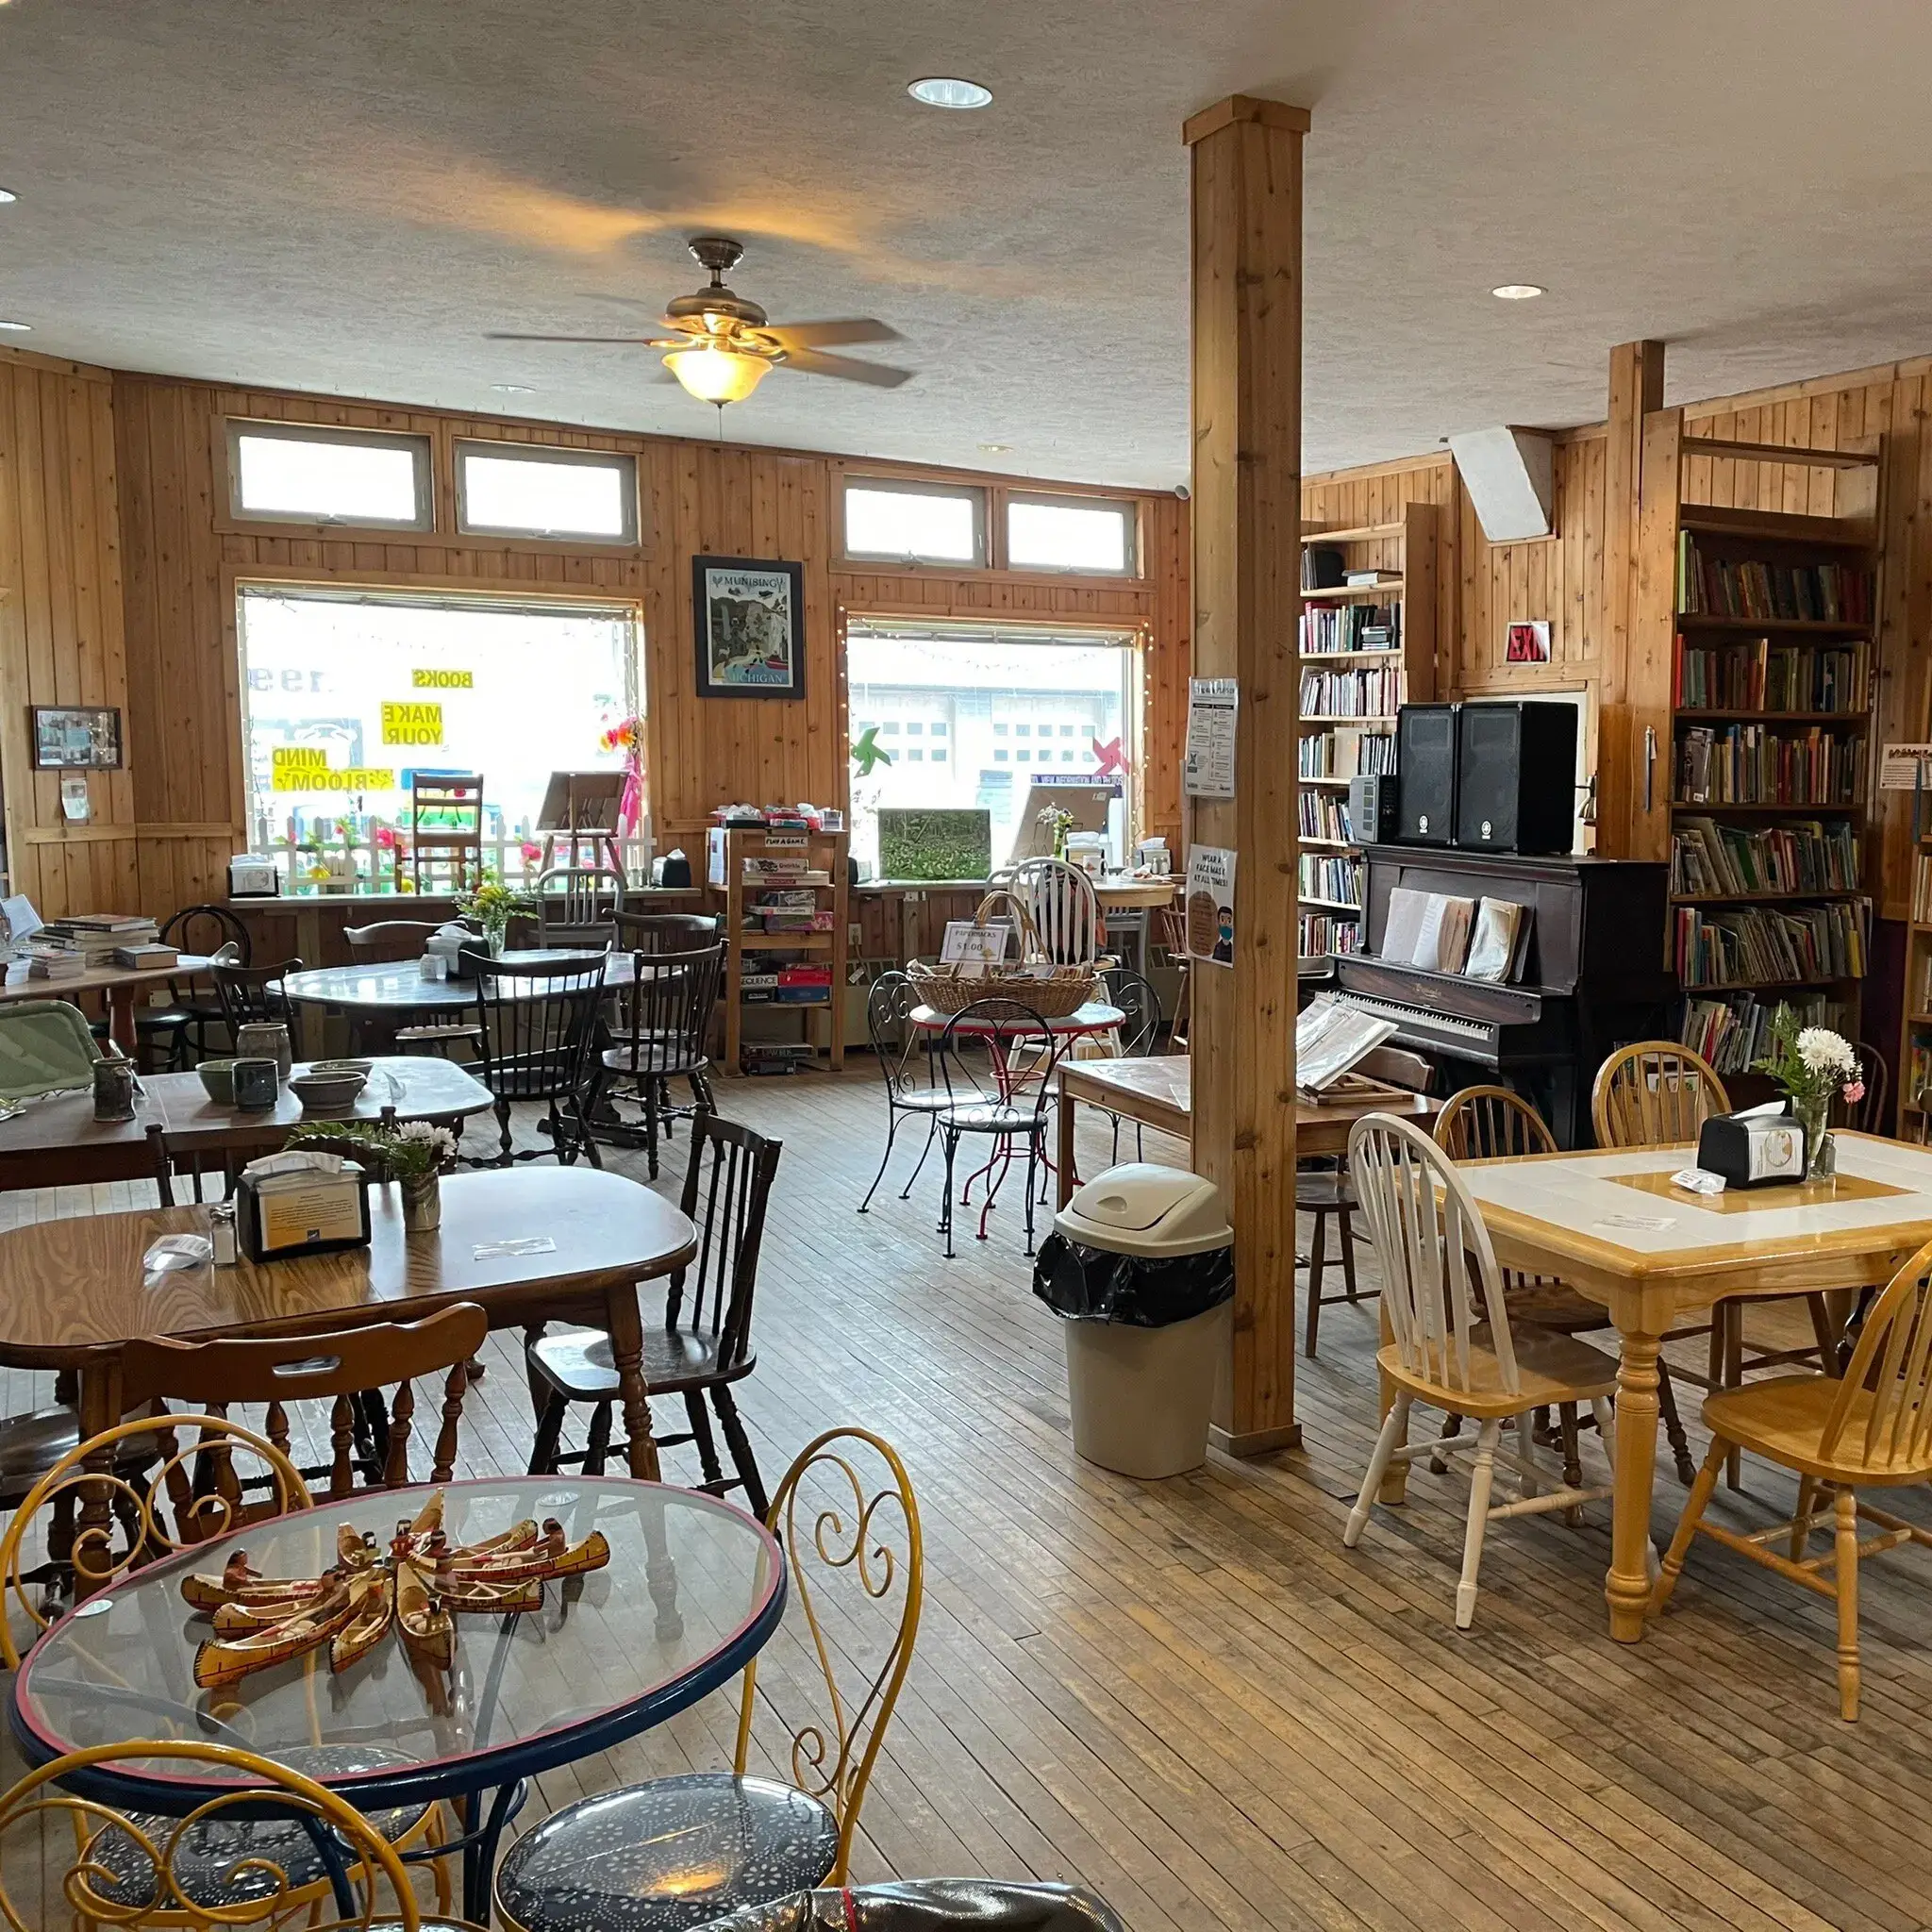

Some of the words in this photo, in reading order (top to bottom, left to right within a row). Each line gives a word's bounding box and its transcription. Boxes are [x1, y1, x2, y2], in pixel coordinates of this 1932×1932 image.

[724, 576, 777, 588] MUNISING
[1210, 866, 1225, 875] MASK
[741, 975, 776, 986] EQUENCE
